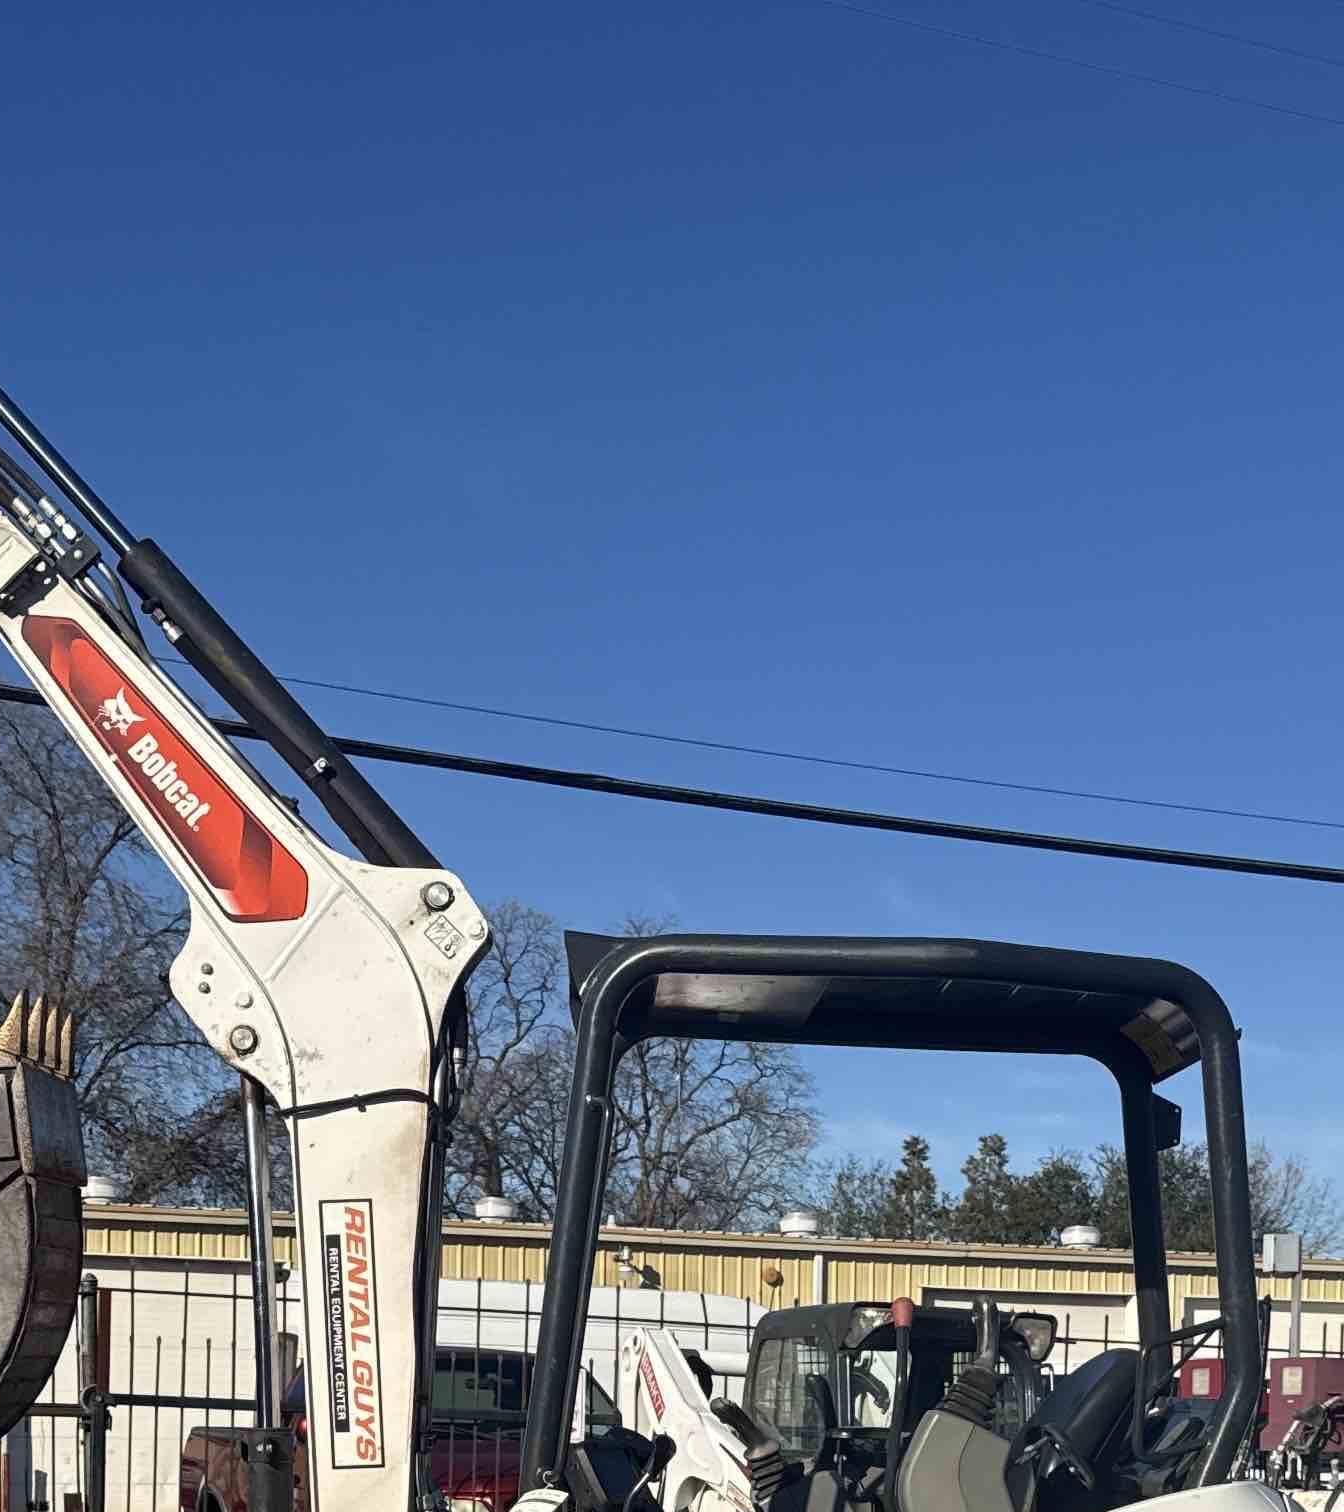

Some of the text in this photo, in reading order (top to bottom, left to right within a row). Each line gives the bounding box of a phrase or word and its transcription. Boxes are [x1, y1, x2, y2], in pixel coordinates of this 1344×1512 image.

[128, 732, 210, 828] Bobcat
[329, 1247, 346, 1421] RENTAL EQUIPMENT CENTER
[344, 1206, 377, 1462] RENTAL GUYS
